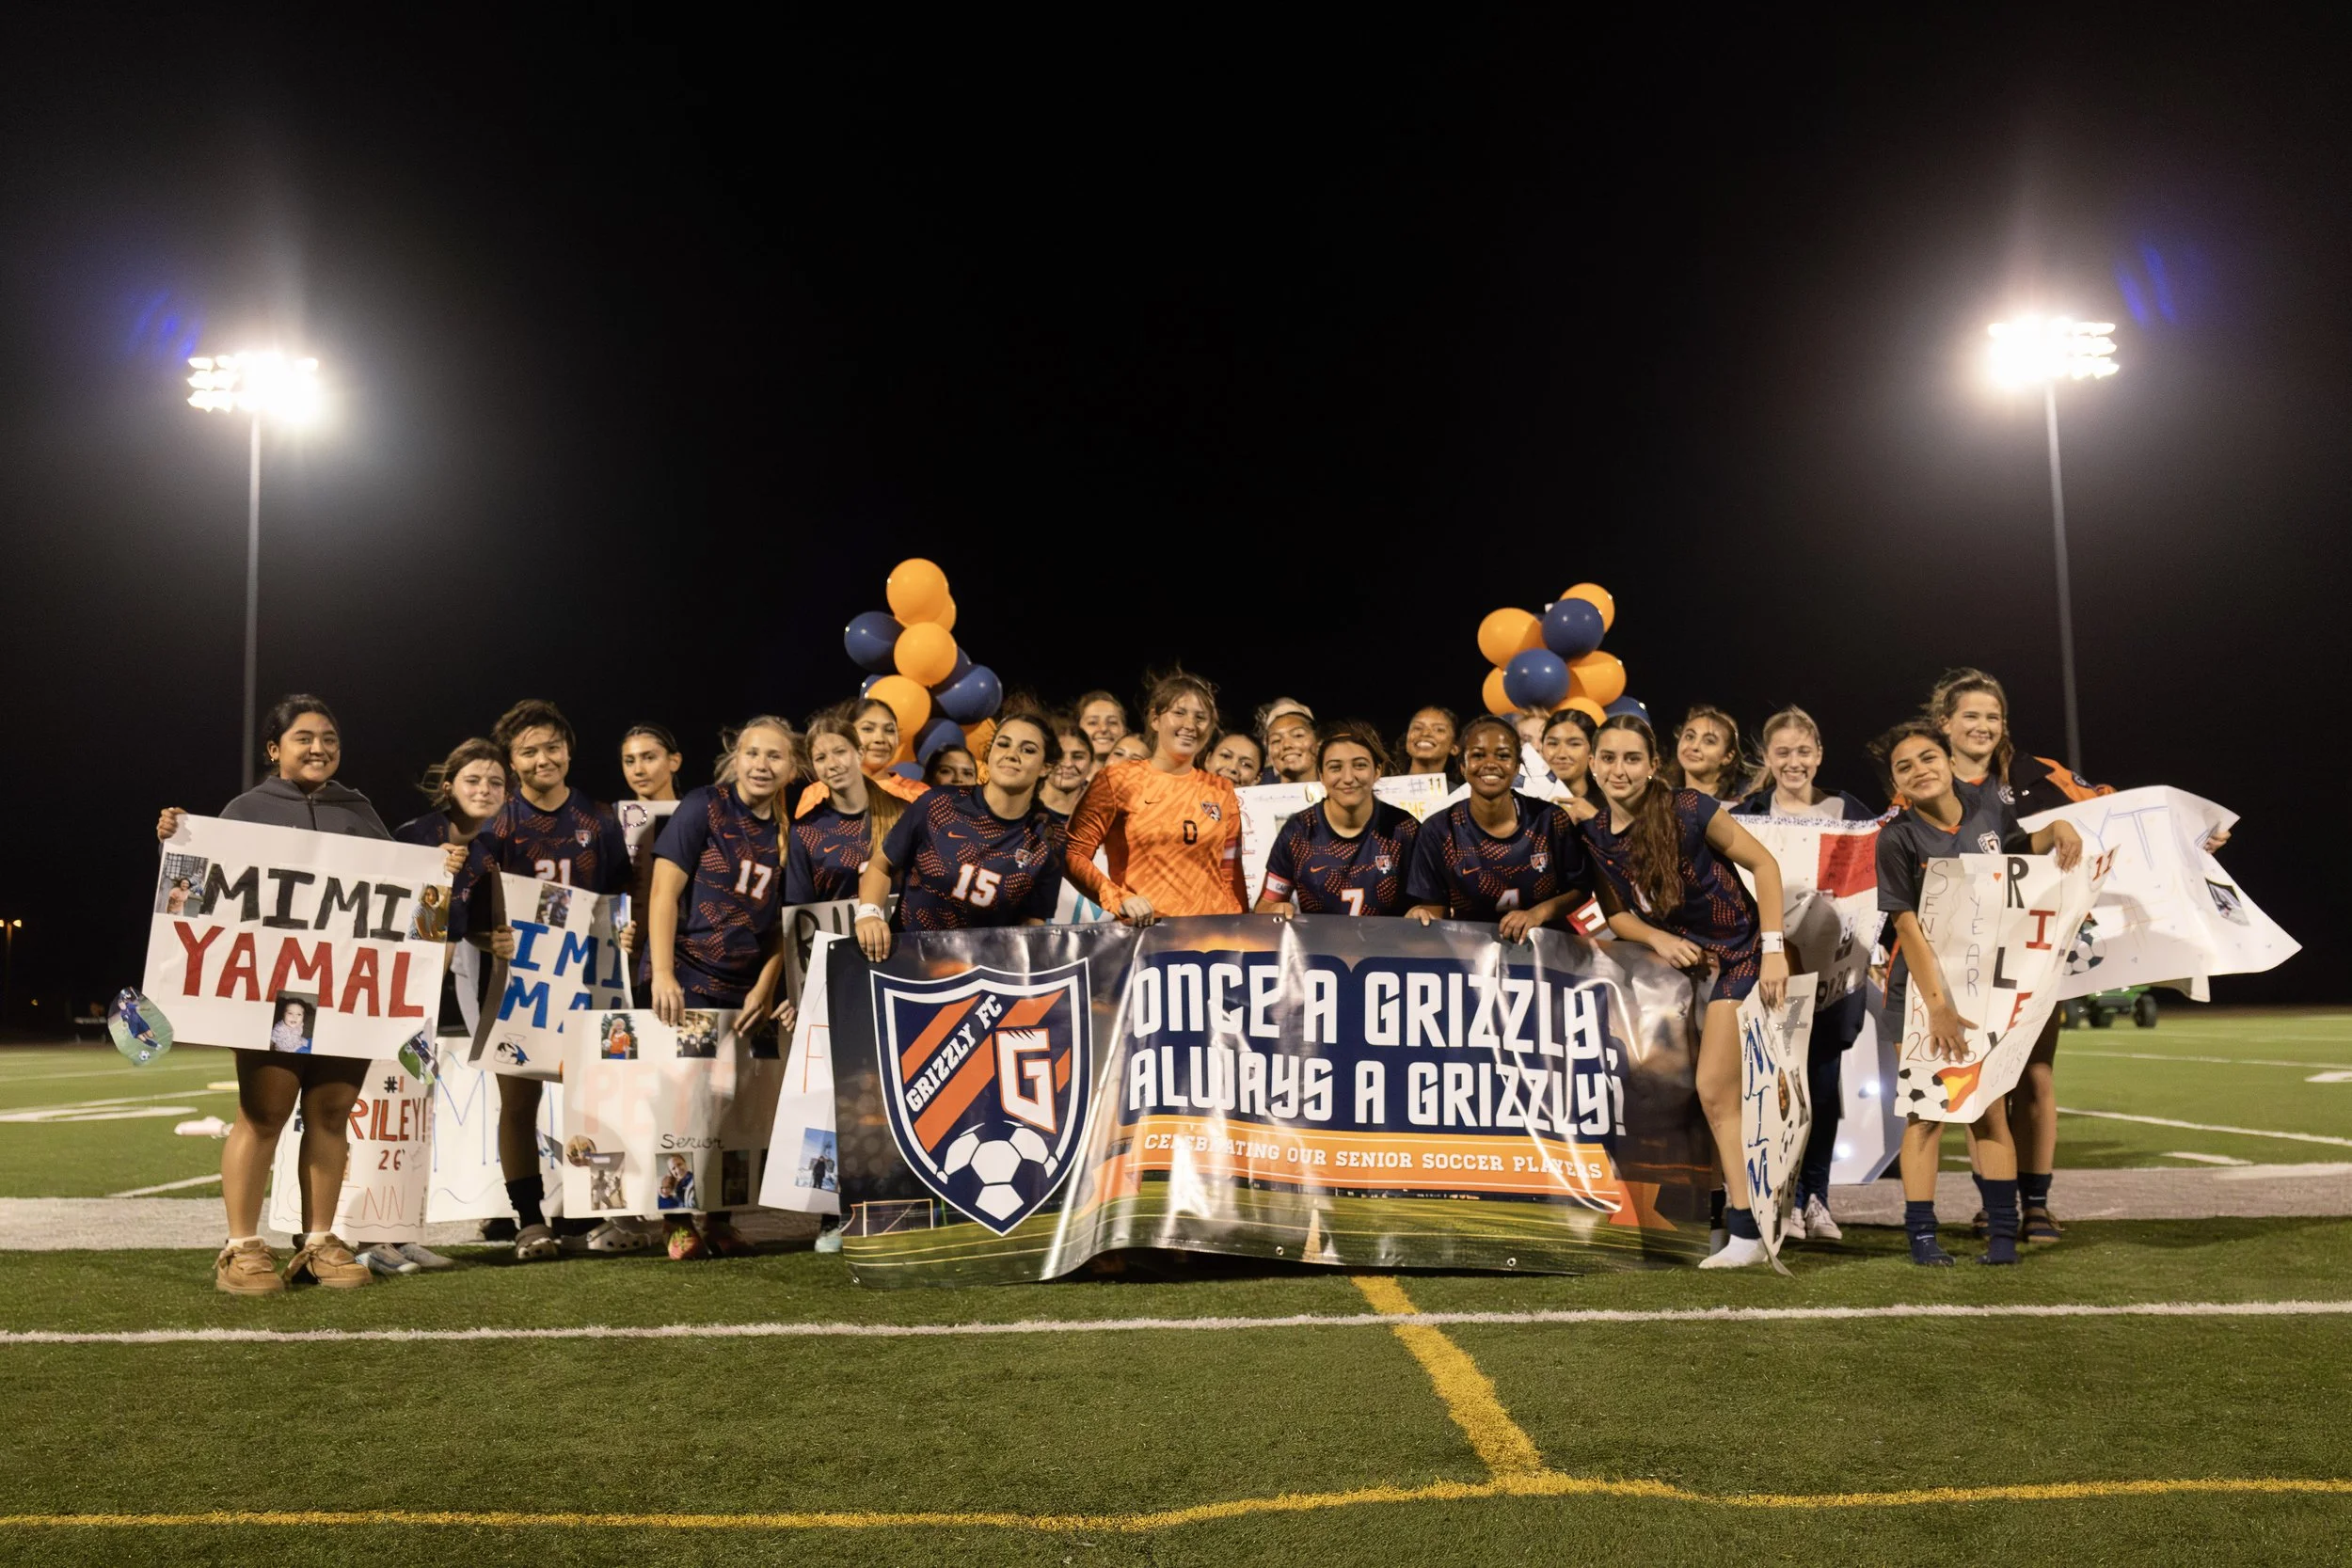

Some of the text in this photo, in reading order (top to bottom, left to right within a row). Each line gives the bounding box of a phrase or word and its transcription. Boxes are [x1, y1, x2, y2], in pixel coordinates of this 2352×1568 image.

[200, 863, 412, 942] MIMI
[534, 860, 571, 885] 21
[734, 860, 772, 900] 17
[951, 863, 1002, 907] 15
[173, 921, 424, 1019] YAMAL
[1133, 962, 1619, 1071] ONCE A GRIZZLY,
[905, 994, 1003, 1112] GRIZZLY FC
[1129, 1045, 1627, 1136] ALWAYS A GRIZZLY!
[660, 1132, 725, 1150] Senior
[1287, 1147, 1327, 1166] OUR
[1335, 1150, 1413, 1169] SENIOR
[1422, 1153, 1504, 1171] SOCCER
[1512, 1156, 1603, 1180] PLAYERS
